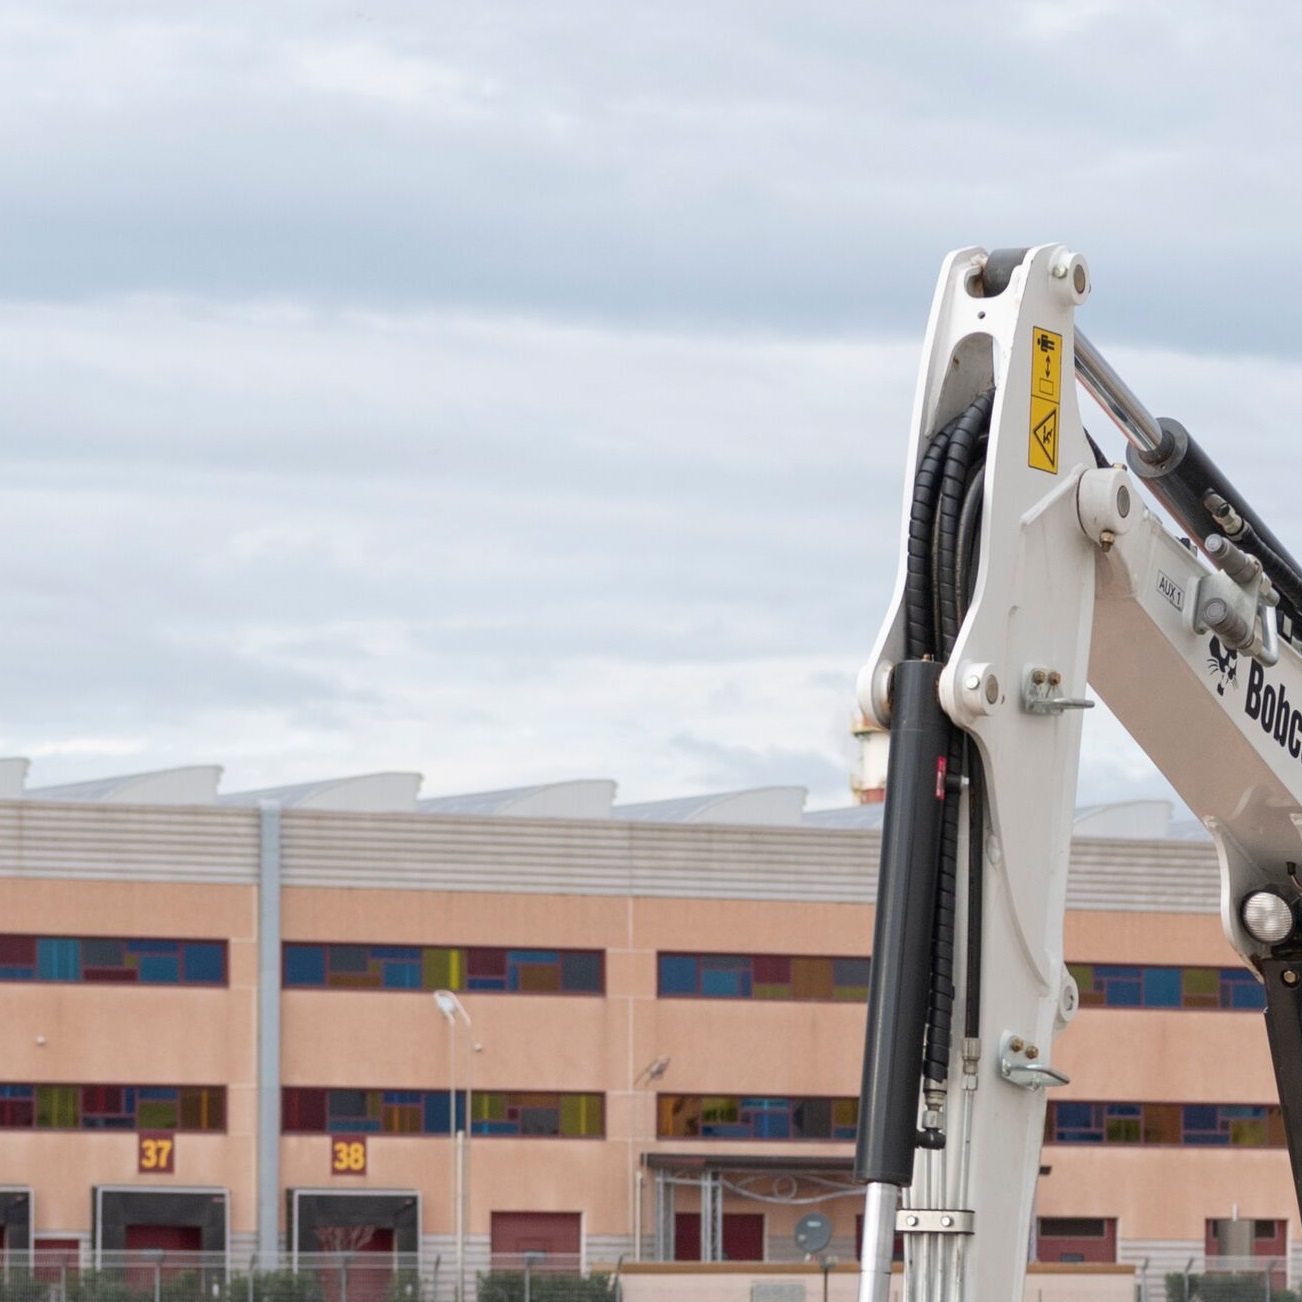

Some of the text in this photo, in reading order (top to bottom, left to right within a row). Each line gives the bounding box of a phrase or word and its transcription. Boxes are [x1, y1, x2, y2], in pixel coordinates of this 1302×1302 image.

[1158, 577, 1182, 605] AUX 1
[141, 1139, 173, 1168] 37
[333, 1142, 366, 1171] 38
